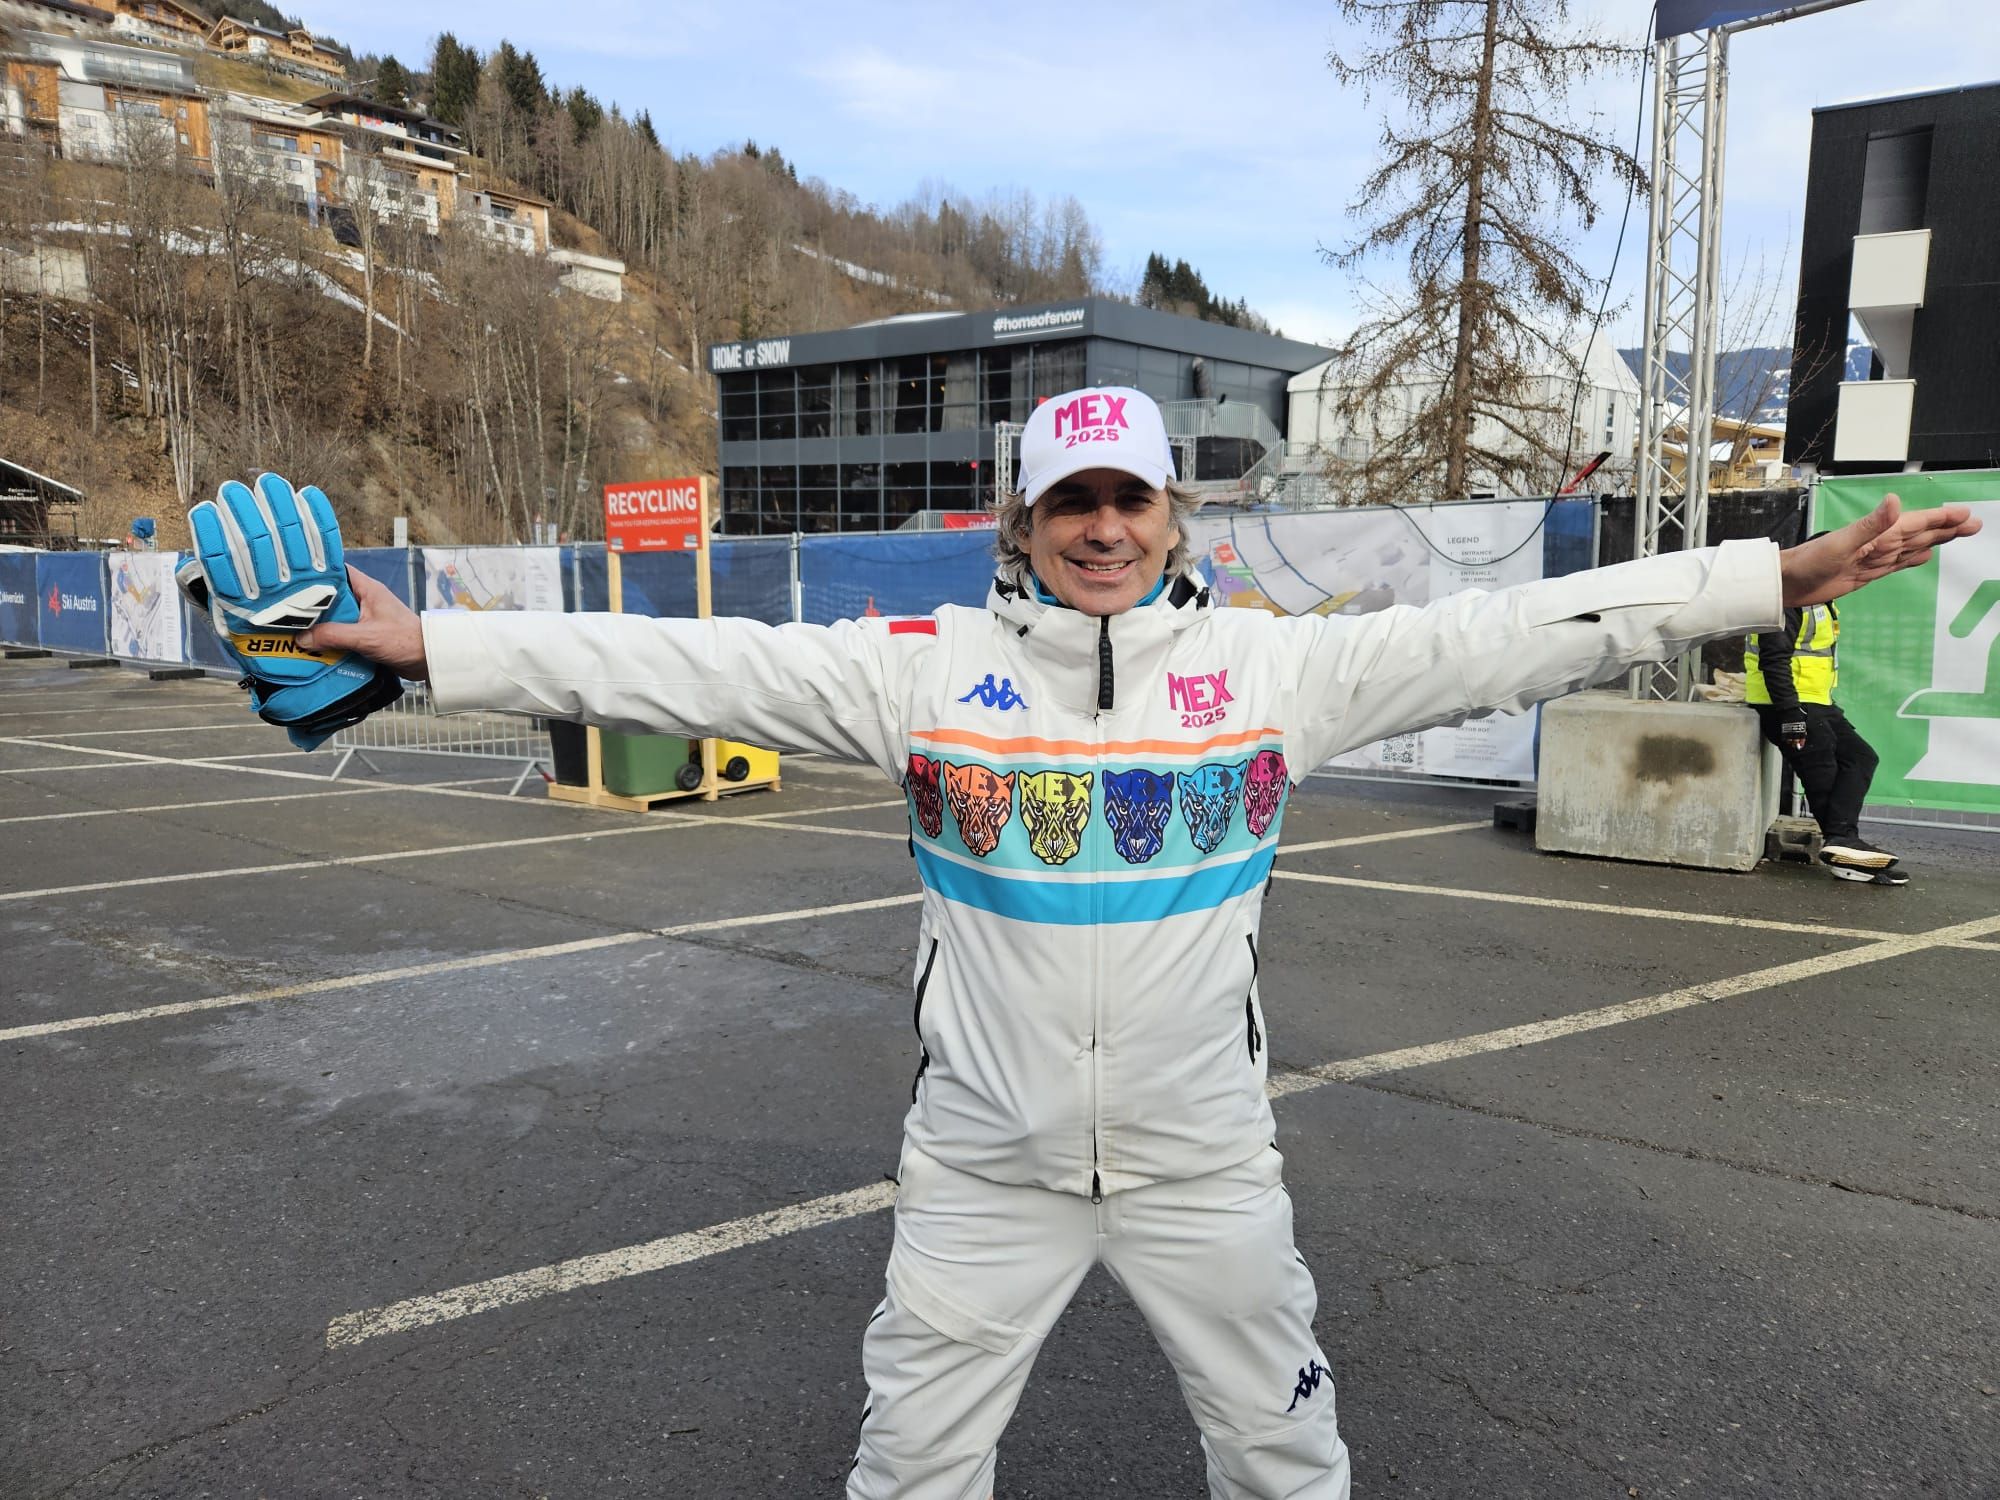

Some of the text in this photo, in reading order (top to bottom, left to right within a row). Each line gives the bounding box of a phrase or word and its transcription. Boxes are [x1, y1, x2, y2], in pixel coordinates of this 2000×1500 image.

[993, 308, 1085, 332] #homeofsnow
[712, 345, 742, 369] HOME
[757, 339, 791, 366] SNOW
[1054, 394, 1129, 440] MEX
[1065, 428, 1120, 449] 2025
[607, 486, 697, 515] RECYCLING
[1447, 536, 1480, 544] LEGEND
[62, 593, 97, 612] Ski Austria
[1166, 669, 1235, 713] MEX
[1180, 706, 1226, 728] 2025
[1019, 772, 1094, 803] MEX
